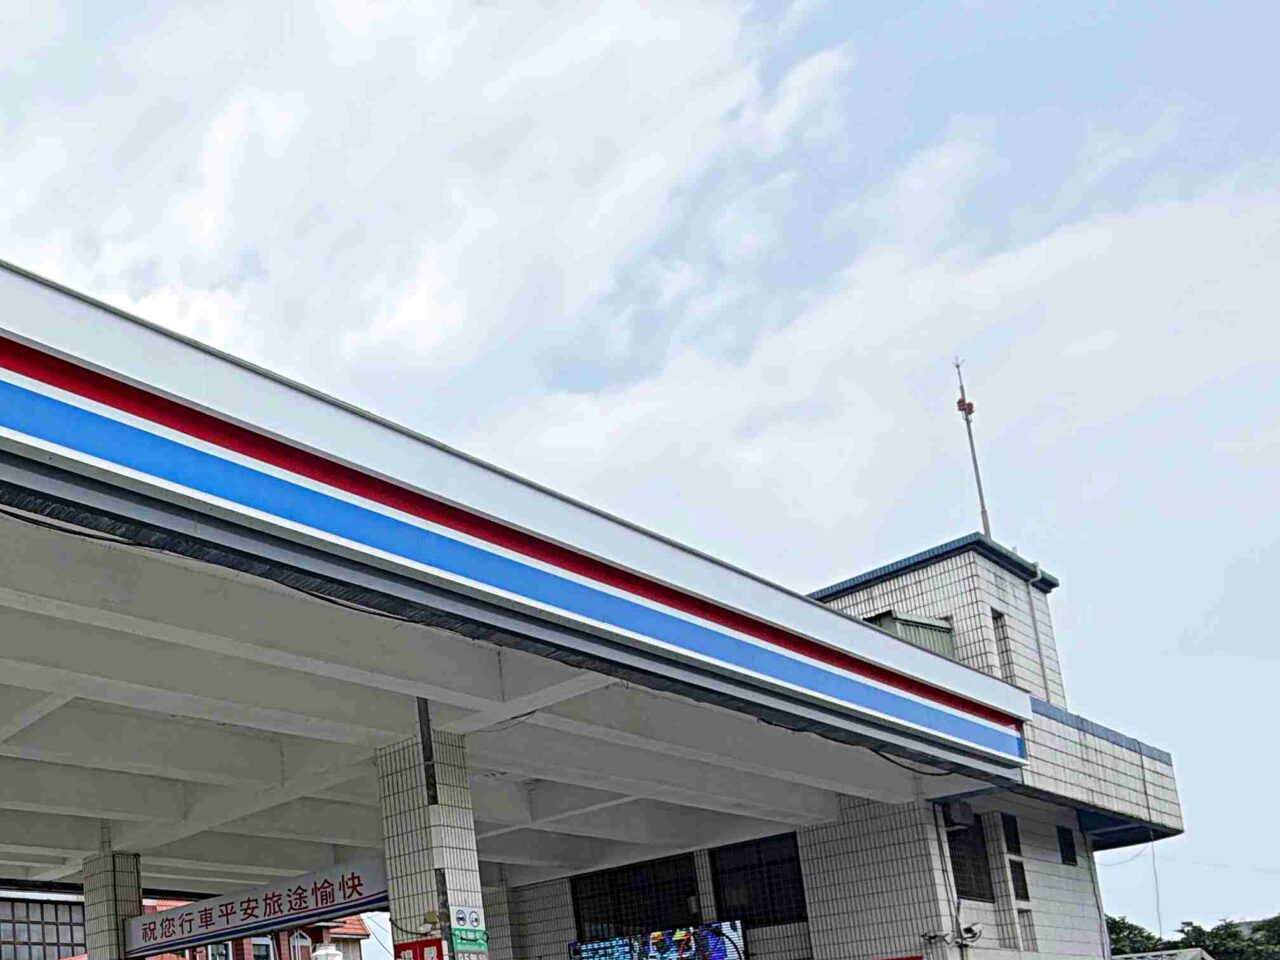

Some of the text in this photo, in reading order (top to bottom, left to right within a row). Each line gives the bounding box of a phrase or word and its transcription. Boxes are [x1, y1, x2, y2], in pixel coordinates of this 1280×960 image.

[141, 871, 364, 944] 祝您行車平安旅途愉快
